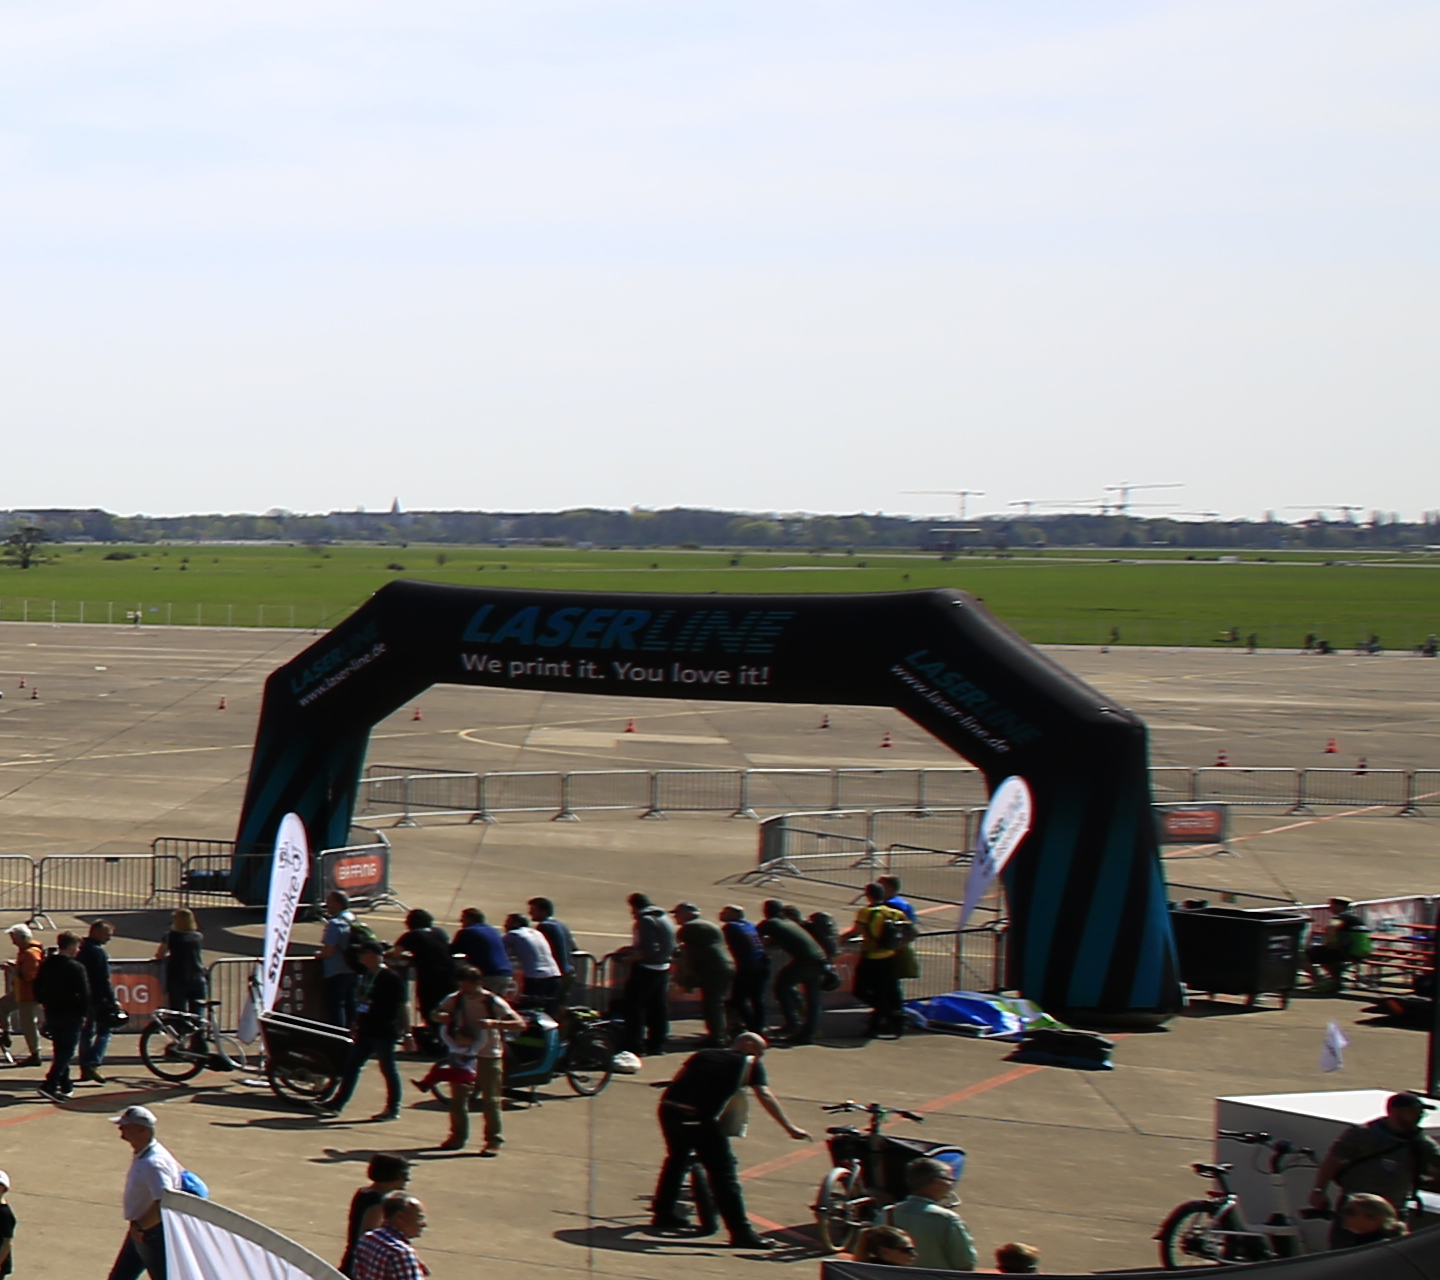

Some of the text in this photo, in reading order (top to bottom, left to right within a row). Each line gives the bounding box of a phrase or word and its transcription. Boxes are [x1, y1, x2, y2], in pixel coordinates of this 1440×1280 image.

[290, 621, 378, 694] LASERLINE
[461, 604, 796, 654] LASERLINE
[298, 642, 387, 707] www.laser-line.de
[460, 653, 772, 686] We print it. You love it!
[905, 649, 1042, 744] LASERLINE
[890, 665, 1010, 753] www.laser-line.de
